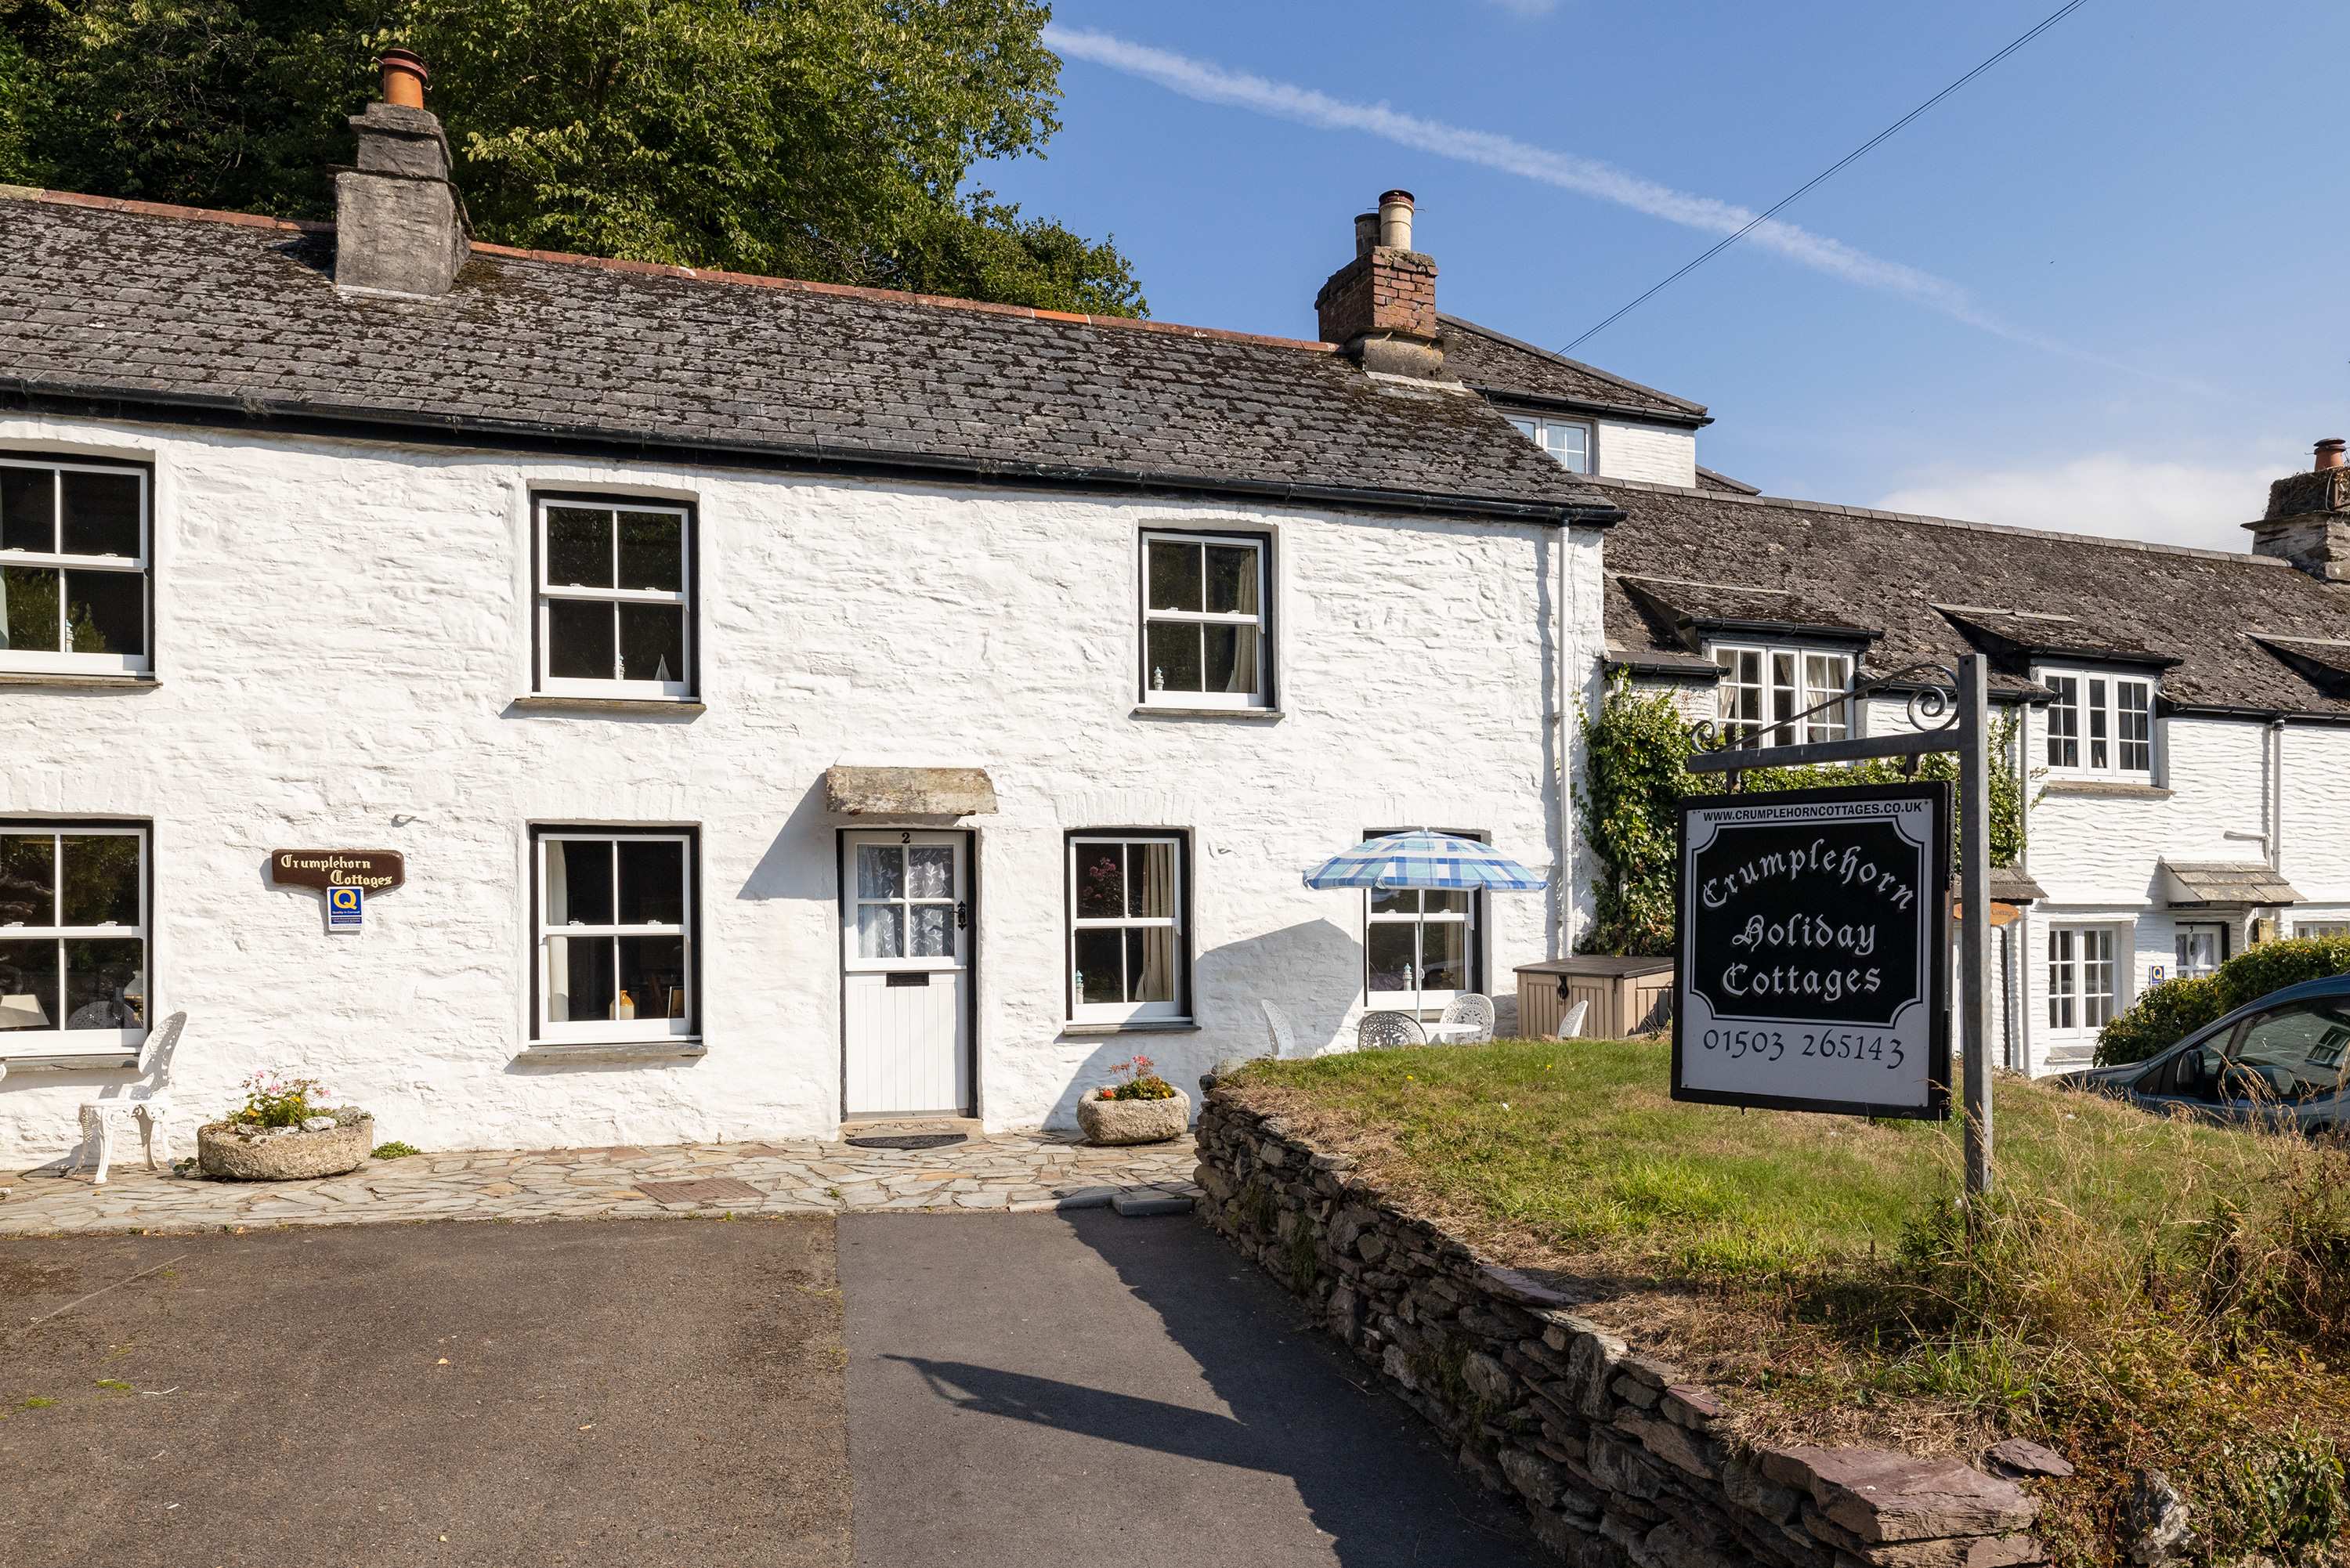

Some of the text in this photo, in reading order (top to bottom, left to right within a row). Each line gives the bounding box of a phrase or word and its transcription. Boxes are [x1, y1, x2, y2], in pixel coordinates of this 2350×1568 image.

[1704, 801, 1922, 822] WWW.CRUMPLEHORNCOTTAGES.CO.UK
[902, 833, 910, 844] 2
[281, 854, 371, 871] Crumplehorn
[330, 870, 392, 887] Cottages
[1703, 839, 1914, 909] Crumplehorn
[334, 890, 357, 909] Q
[1732, 913, 1876, 956] Holiday
[1722, 962, 1882, 1002] Cottages
[2153, 966, 2162, 979] Q
[1704, 1028, 1905, 1069] 01503 265143
